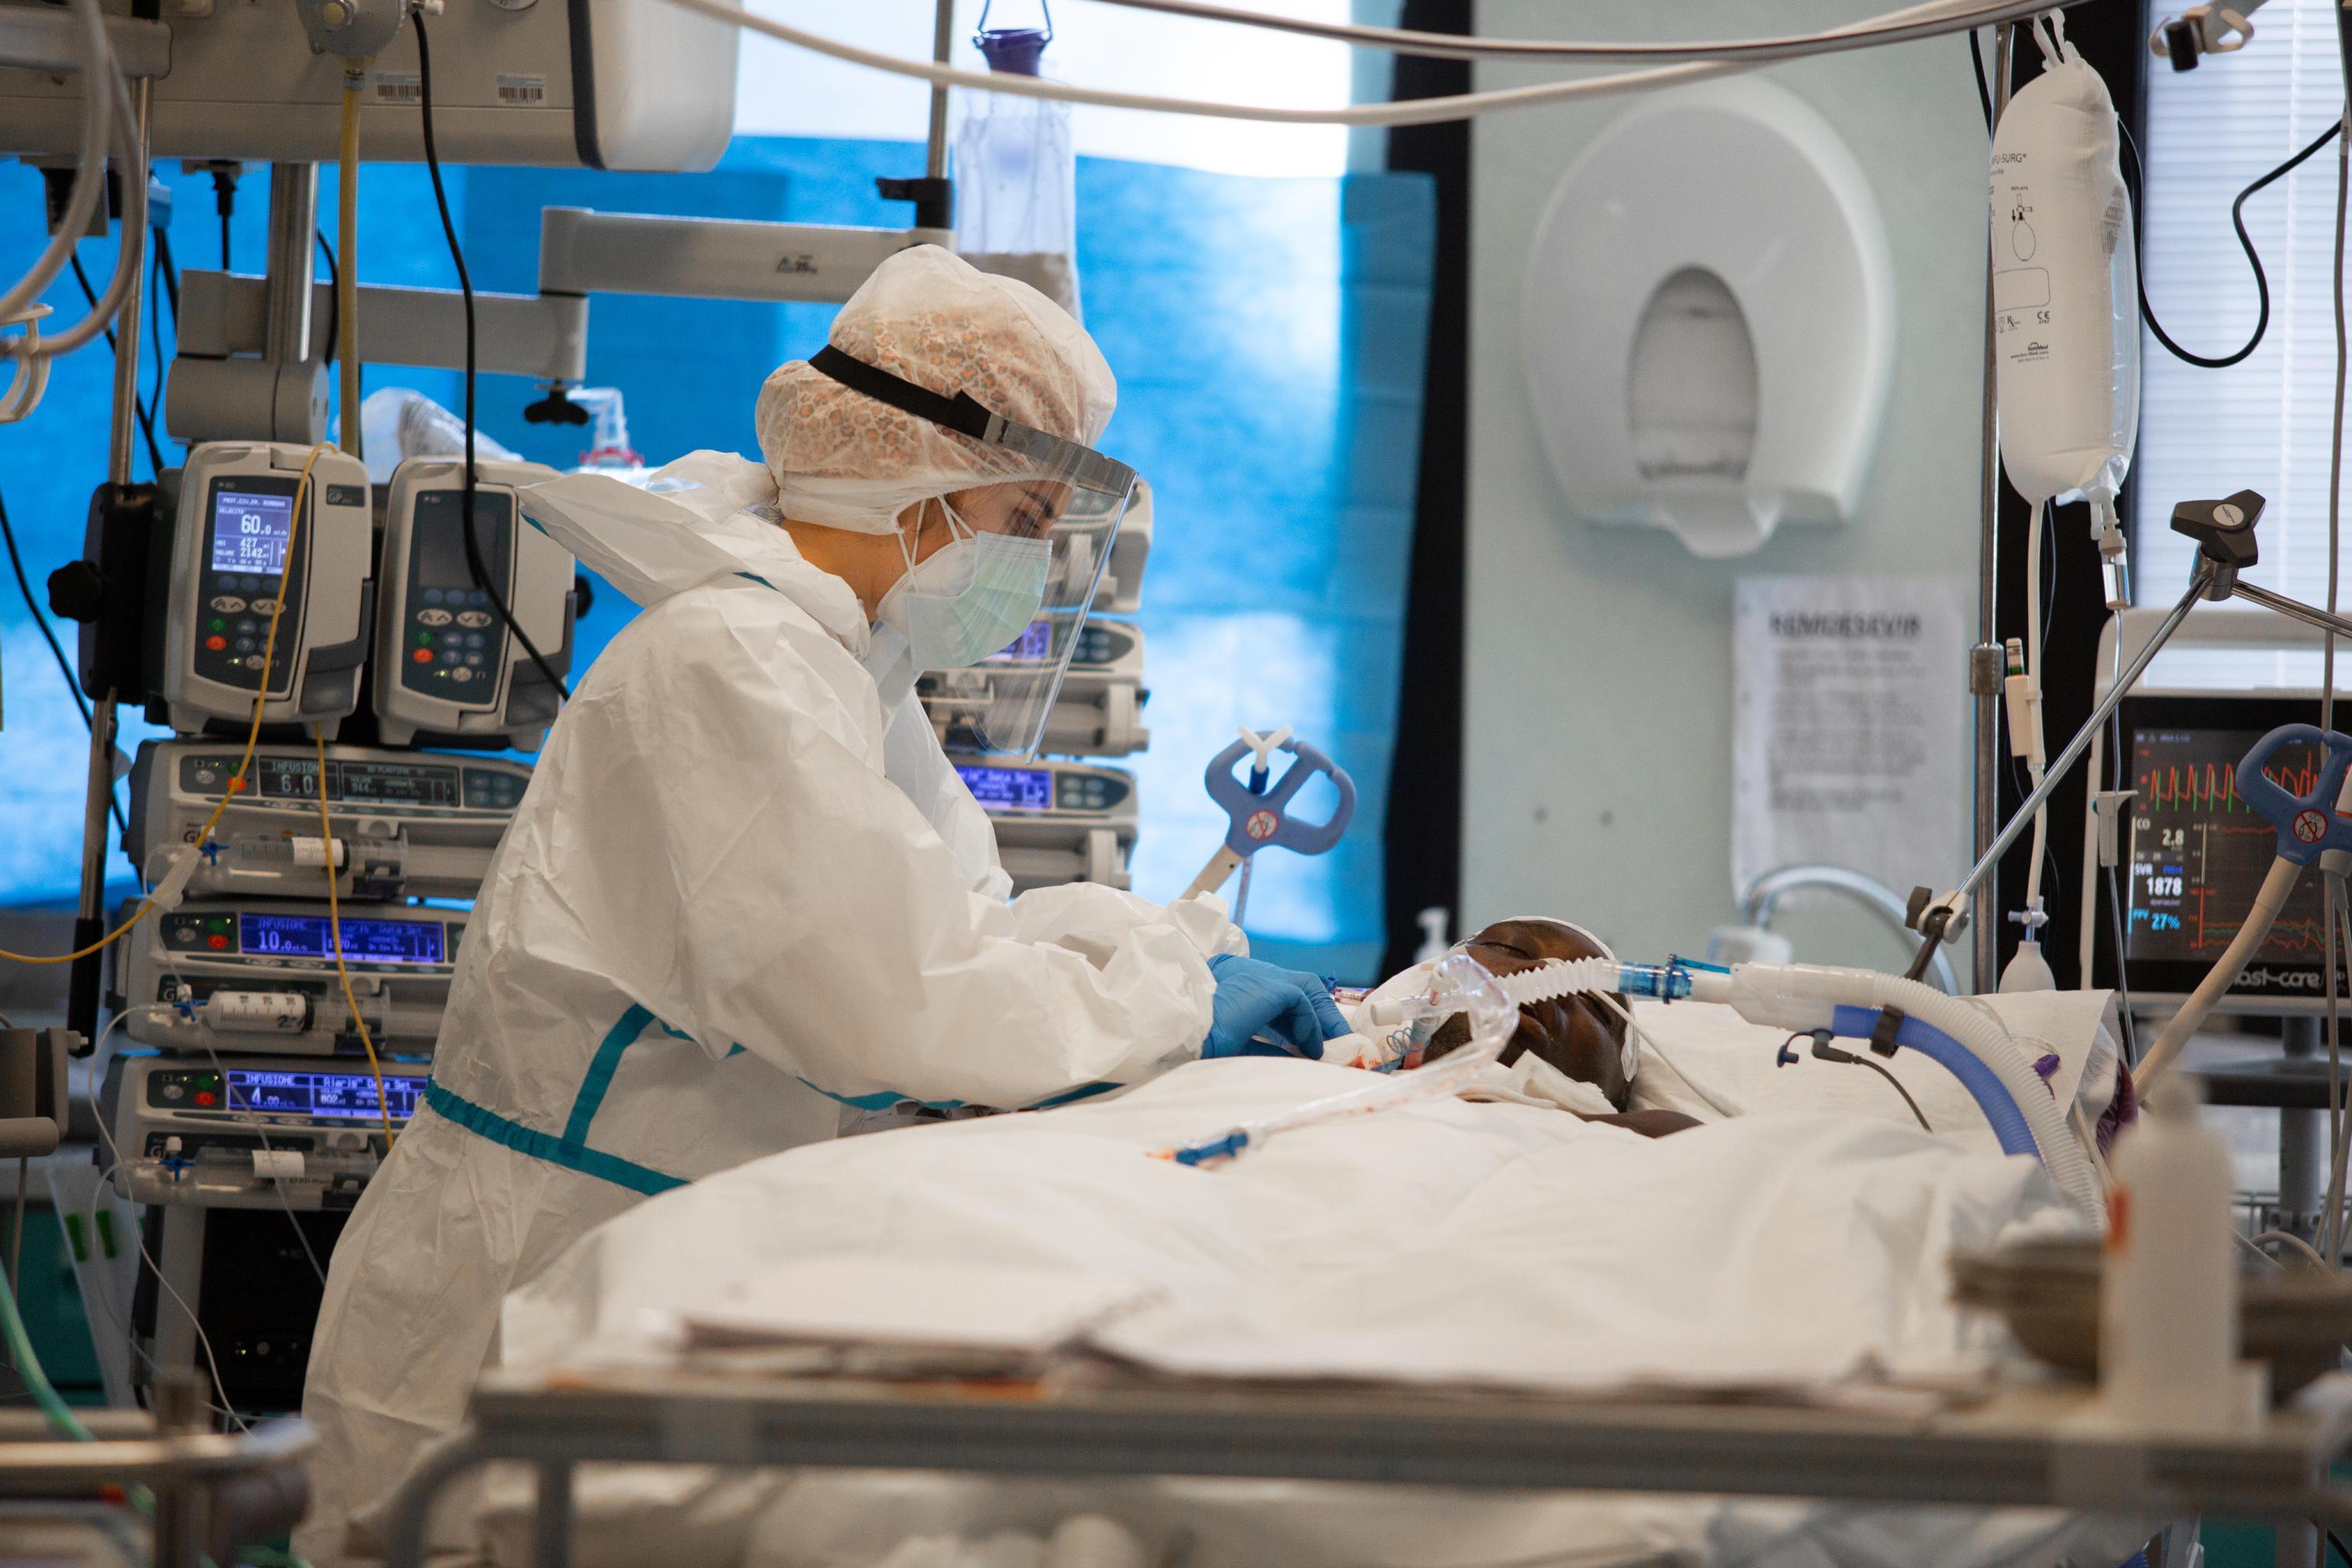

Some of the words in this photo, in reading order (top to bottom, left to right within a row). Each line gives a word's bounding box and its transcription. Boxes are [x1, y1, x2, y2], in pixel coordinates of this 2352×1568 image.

[240, 514, 272, 535] 60.0
[240, 547, 263, 558] 2142
[272, 759, 320, 773] INFUSION
[2161, 828, 2184, 847] 2.8
[2134, 862, 2154, 876] SVR
[2146, 876, 2183, 897] 1878
